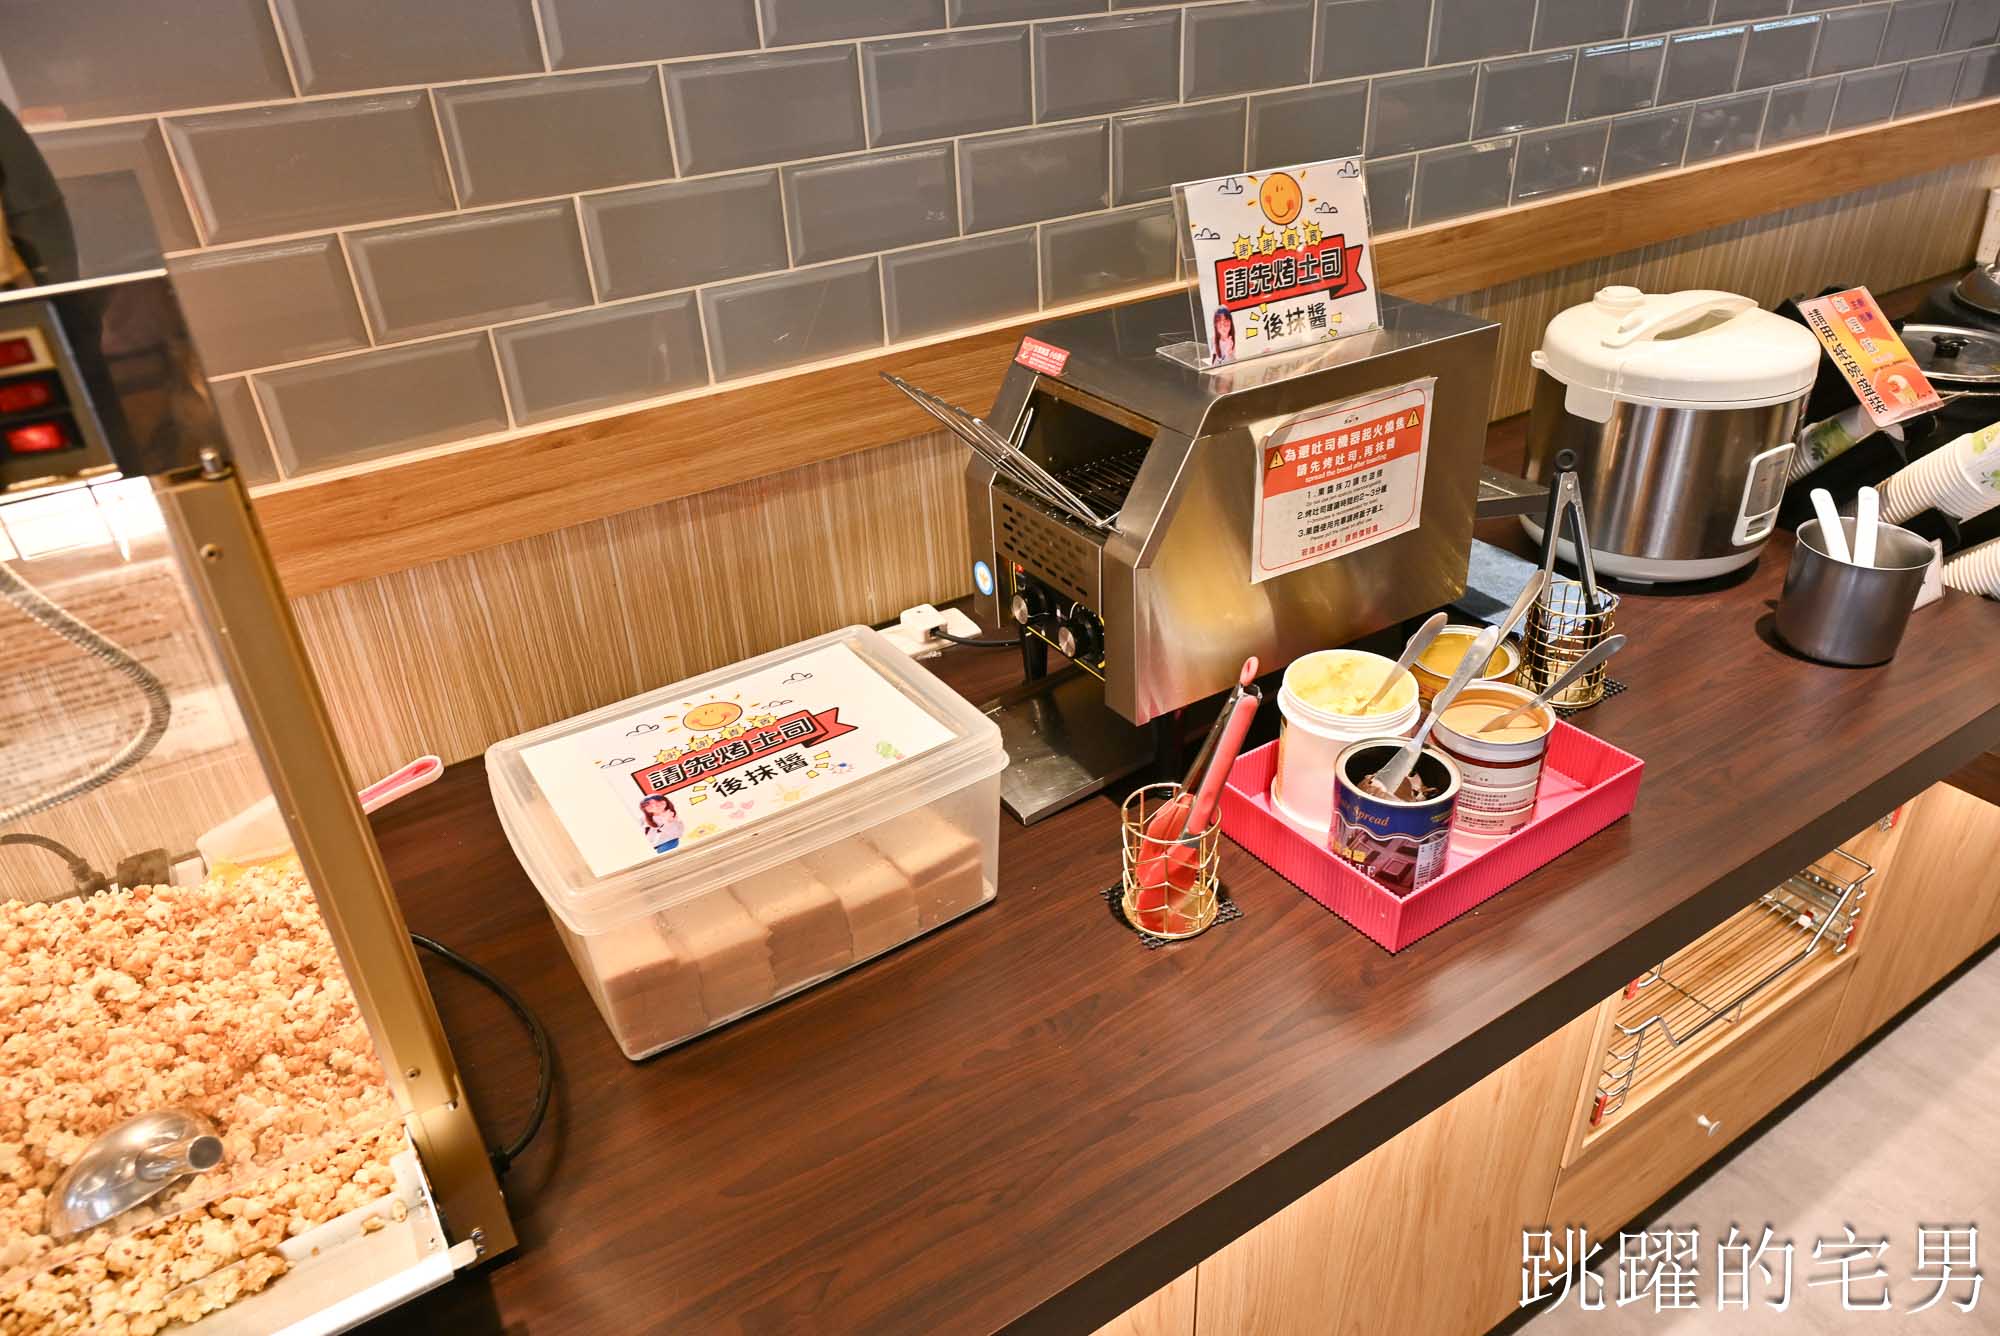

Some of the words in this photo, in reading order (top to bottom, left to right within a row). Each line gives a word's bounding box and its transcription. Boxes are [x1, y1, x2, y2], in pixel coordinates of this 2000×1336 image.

[1224, 248, 1342, 301] 請先烤土司
[1263, 302, 1327, 340] 後抹醬
[647, 717, 815, 792] 請先烤土司
[712, 753, 809, 798] 後抹醬
[1353, 806, 1390, 827] Spread
